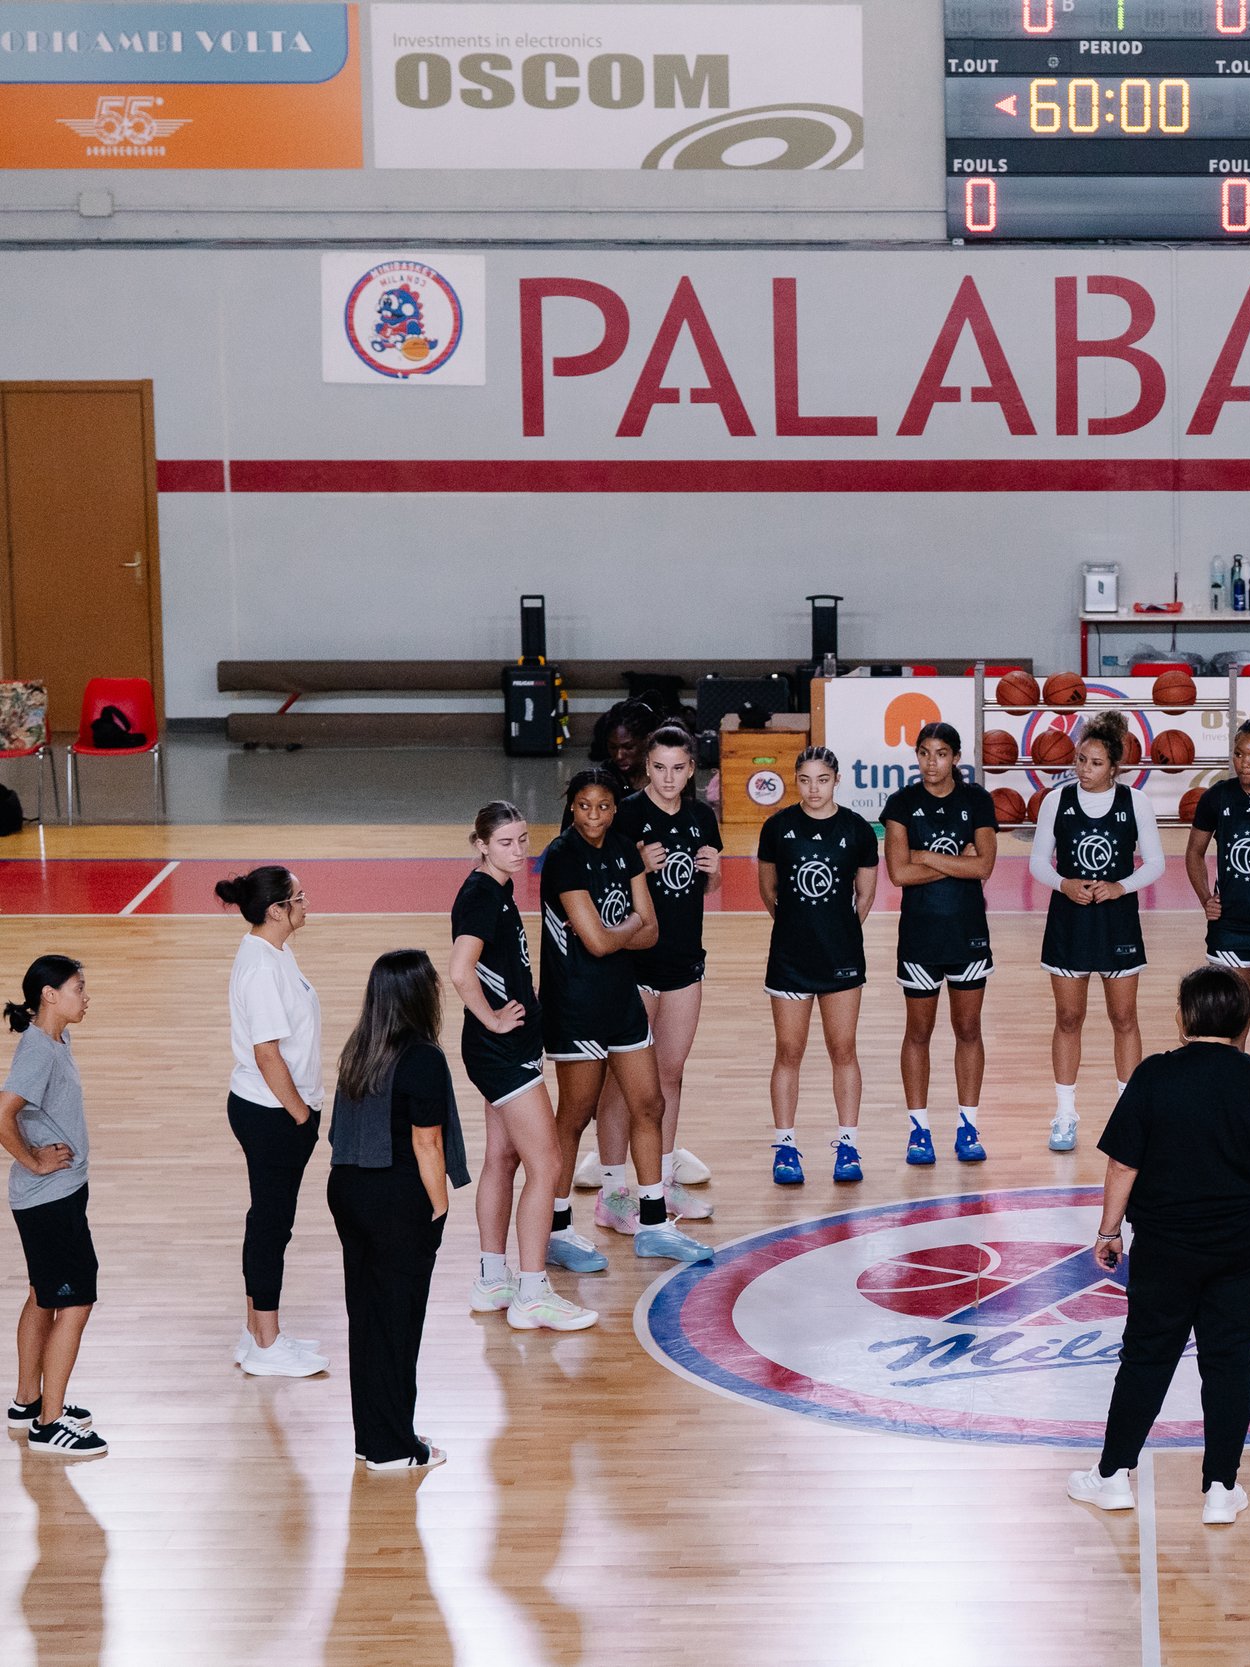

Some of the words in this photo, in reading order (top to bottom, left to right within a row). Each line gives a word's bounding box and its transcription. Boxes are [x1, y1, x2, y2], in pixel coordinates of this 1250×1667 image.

[196, 31, 312, 53] VOLTA
[393, 33, 491, 49] Investments
[496, 33, 510, 48] in
[515, 33, 602, 48] electronics
[1079, 41, 1143, 55] PERIOD
[949, 59, 999, 73] T.OUT
[395, 53, 730, 110] OSCOM
[1030, 79, 1190, 133] 60:00
[953, 159, 1008, 173] FOULS
[965, 177, 996, 232] 0
[852, 799, 874, 808] con
[961, 810, 969, 821] 6
[1115, 811, 1127, 823] 10
[839, 837, 847, 849] 4
